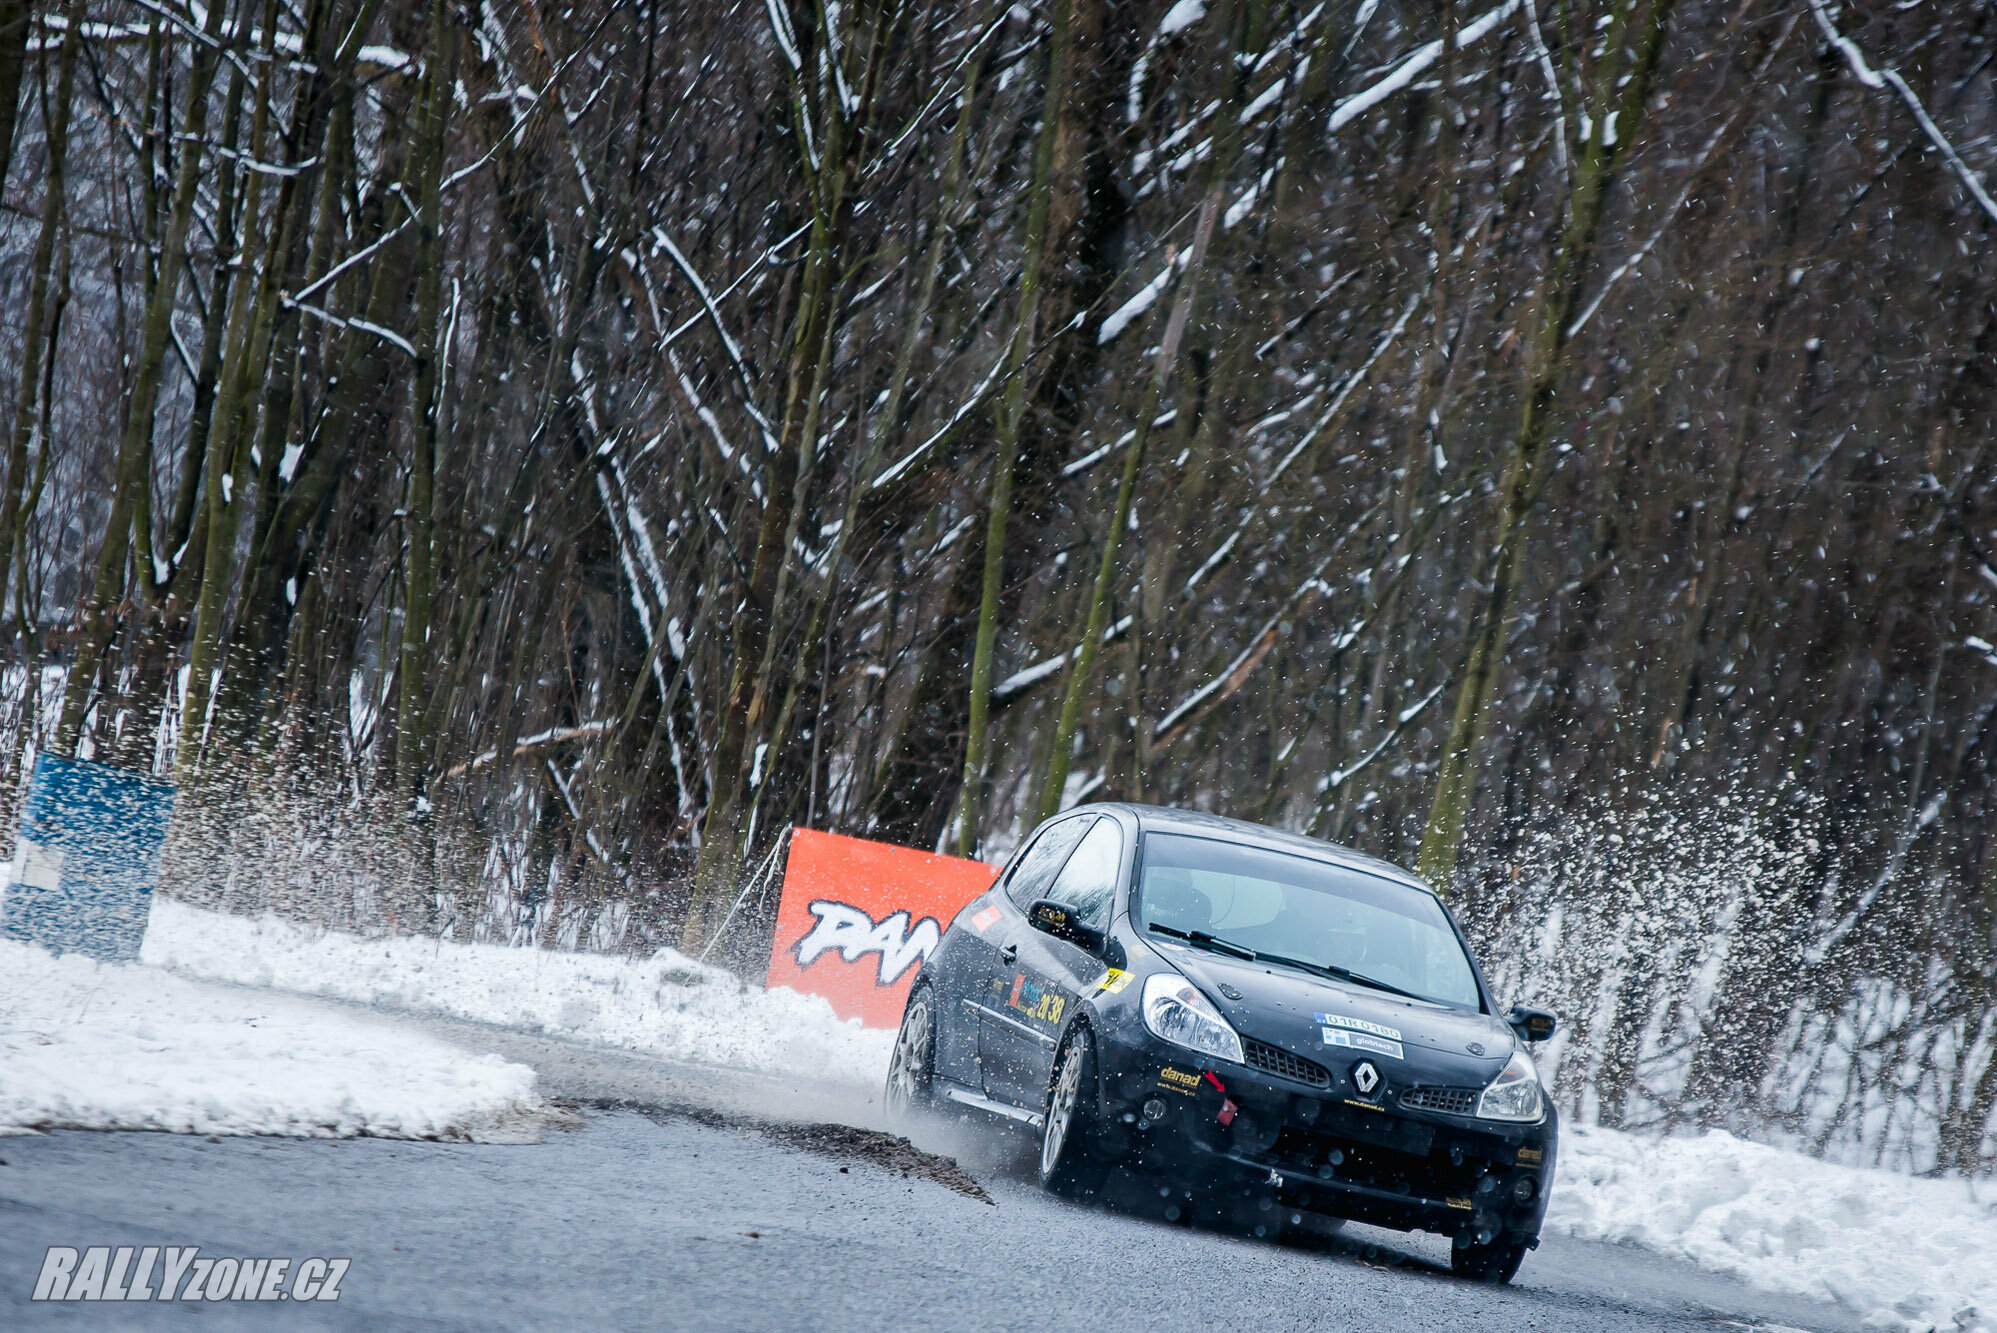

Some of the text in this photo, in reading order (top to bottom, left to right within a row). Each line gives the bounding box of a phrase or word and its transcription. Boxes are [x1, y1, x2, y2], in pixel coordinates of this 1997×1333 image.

[1356, 1037, 1394, 1052] globtech
[1160, 1066, 1201, 1087] danad
[1343, 1098, 1385, 1112] www.danad.cz
